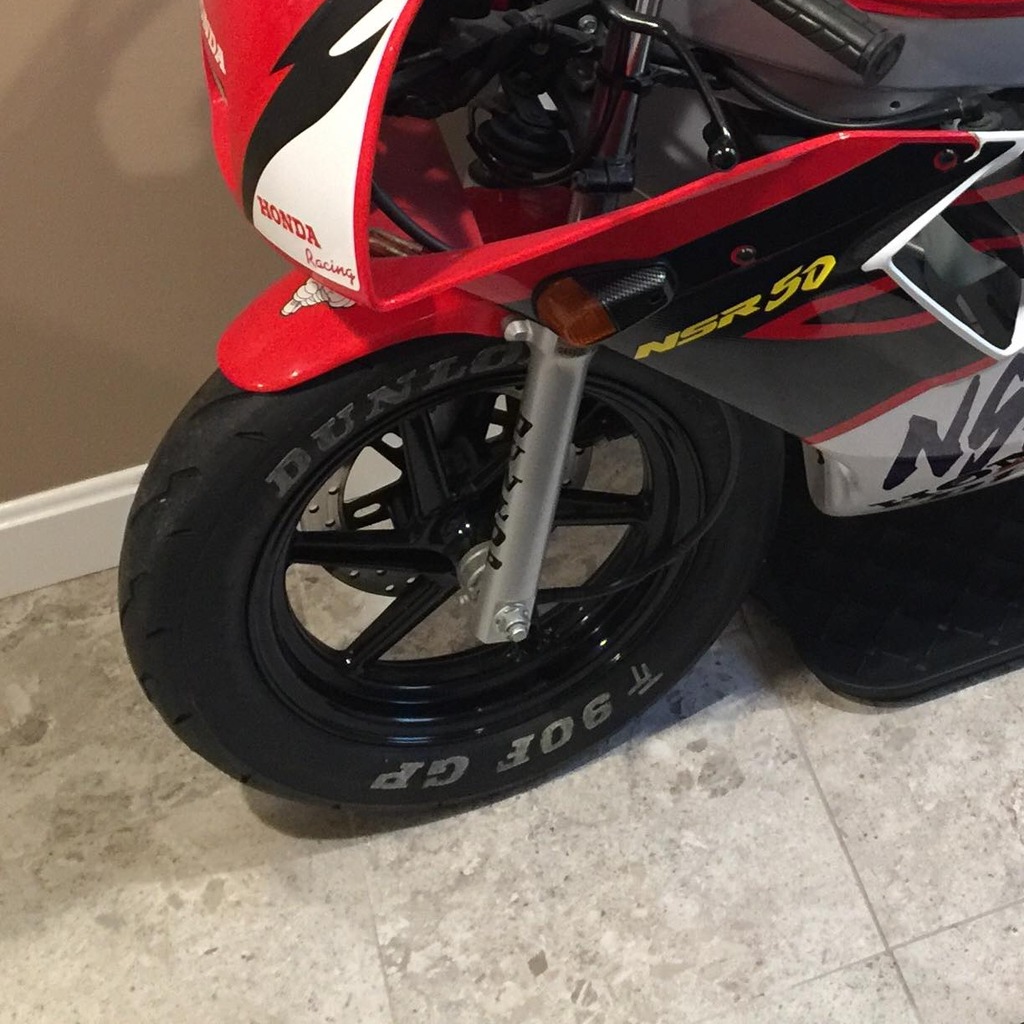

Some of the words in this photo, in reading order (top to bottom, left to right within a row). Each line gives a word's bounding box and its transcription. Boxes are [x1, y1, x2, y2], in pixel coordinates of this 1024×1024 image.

[257, 195, 321, 249] HONDA
[305, 248, 356, 285] Racing
[264, 346, 526, 498] DUNLO
[370, 756, 469, 789] GP
